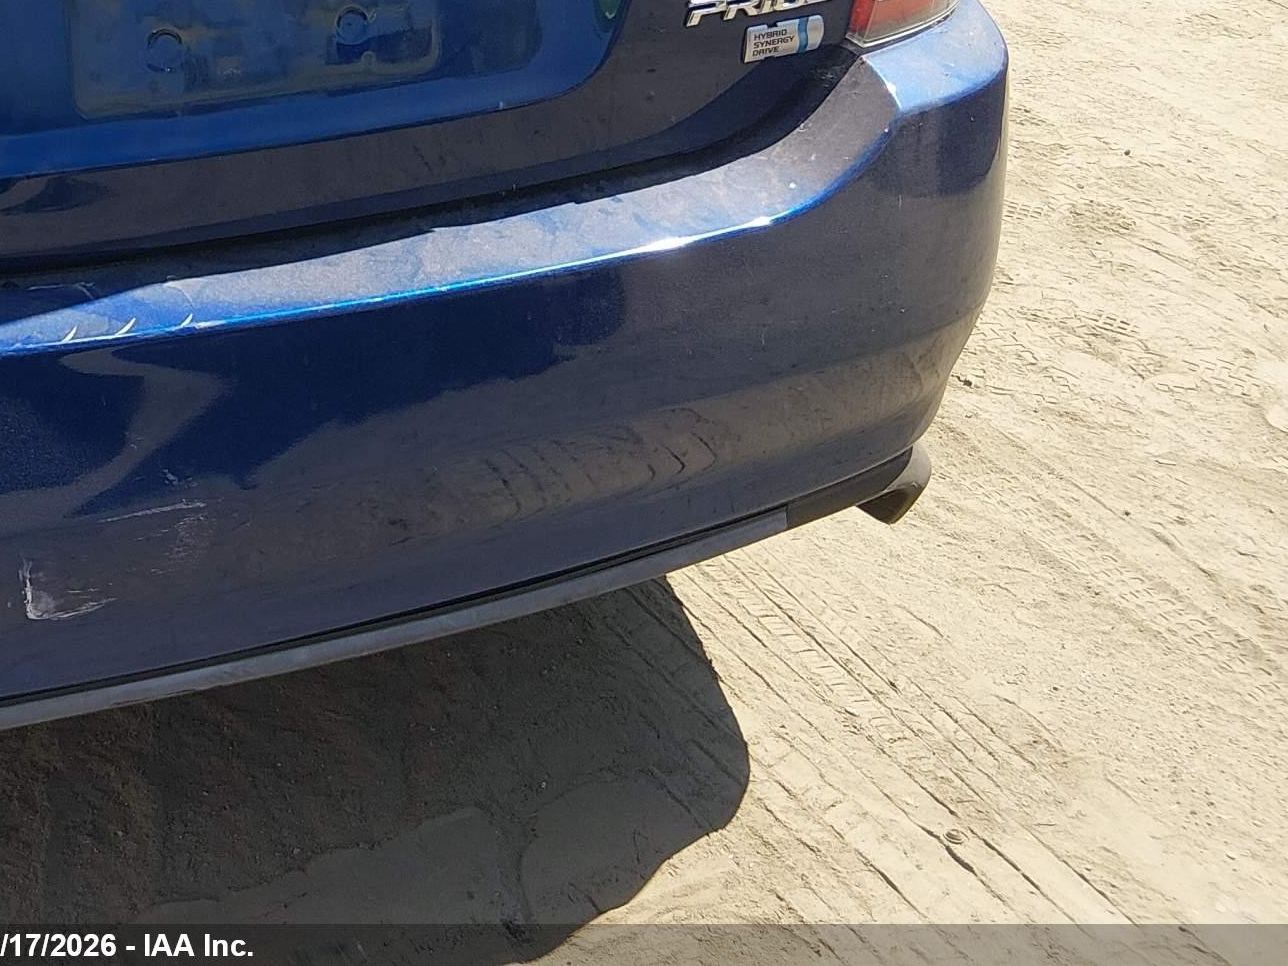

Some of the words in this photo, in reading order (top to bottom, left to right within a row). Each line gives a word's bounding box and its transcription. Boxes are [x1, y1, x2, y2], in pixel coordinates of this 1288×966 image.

[753, 28, 787, 42] HYBRID
[753, 35, 796, 50] SYNERGY
[752, 45, 780, 57] DRIVE
